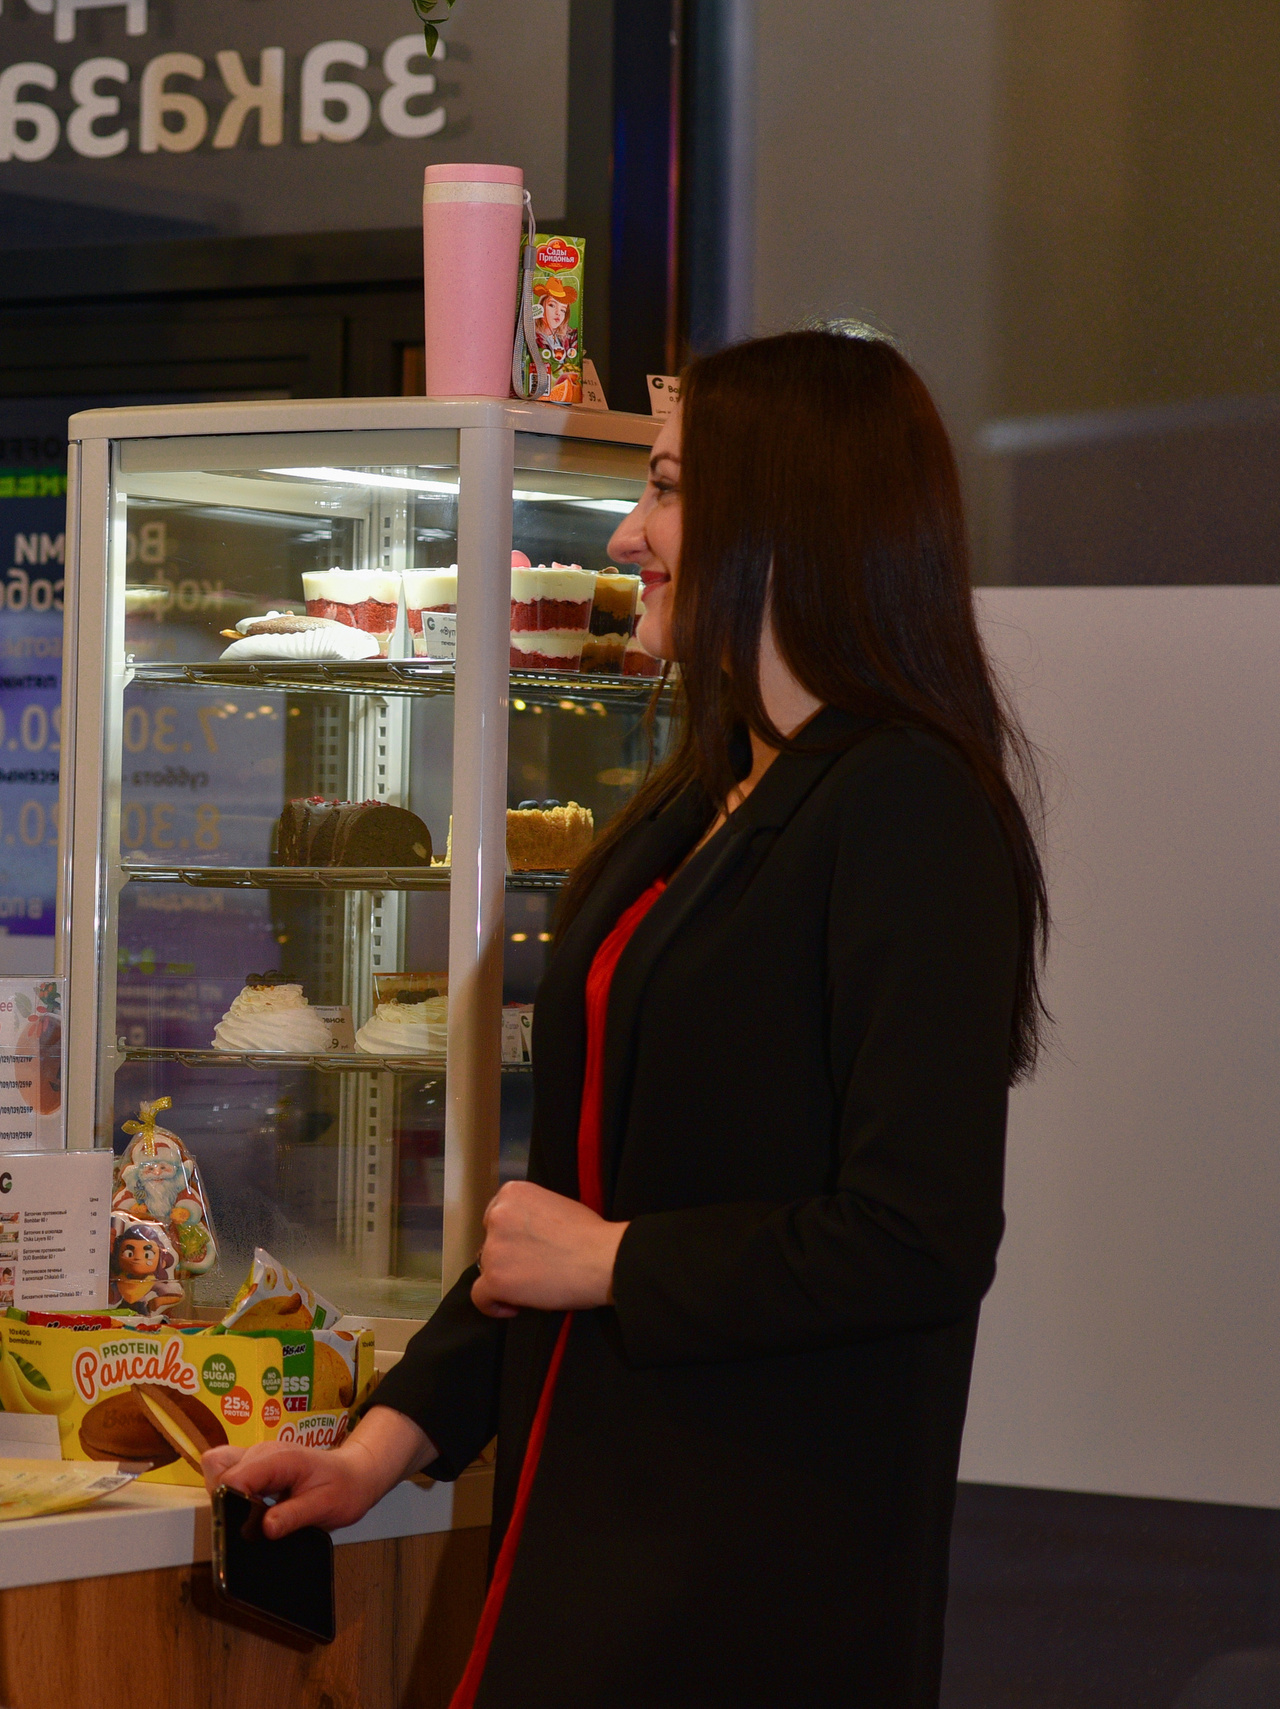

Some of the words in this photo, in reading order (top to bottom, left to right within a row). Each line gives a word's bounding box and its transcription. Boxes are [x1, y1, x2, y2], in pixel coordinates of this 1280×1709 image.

[546, 247, 567, 257] Сады
[539, 252, 575, 264] Придонья
[9, 1328, 30, 1336] 10x40G
[9, 1337, 42, 1346] bombbar.ru
[102, 1342, 159, 1358] PROTEIN
[75, 1341, 196, 1400] Pancake
[211, 1362, 226, 1371] NO
[203, 1370, 235, 1382] SUGAR
[209, 1381, 230, 1389] ADDED
[262, 1378, 281, 1386] SUGAR
[224, 1396, 250, 1411] 25%
[224, 1410, 250, 1418] PROTEIN
[264, 1407, 280, 1416] 25%
[299, 1417, 336, 1431] PROTEIN
